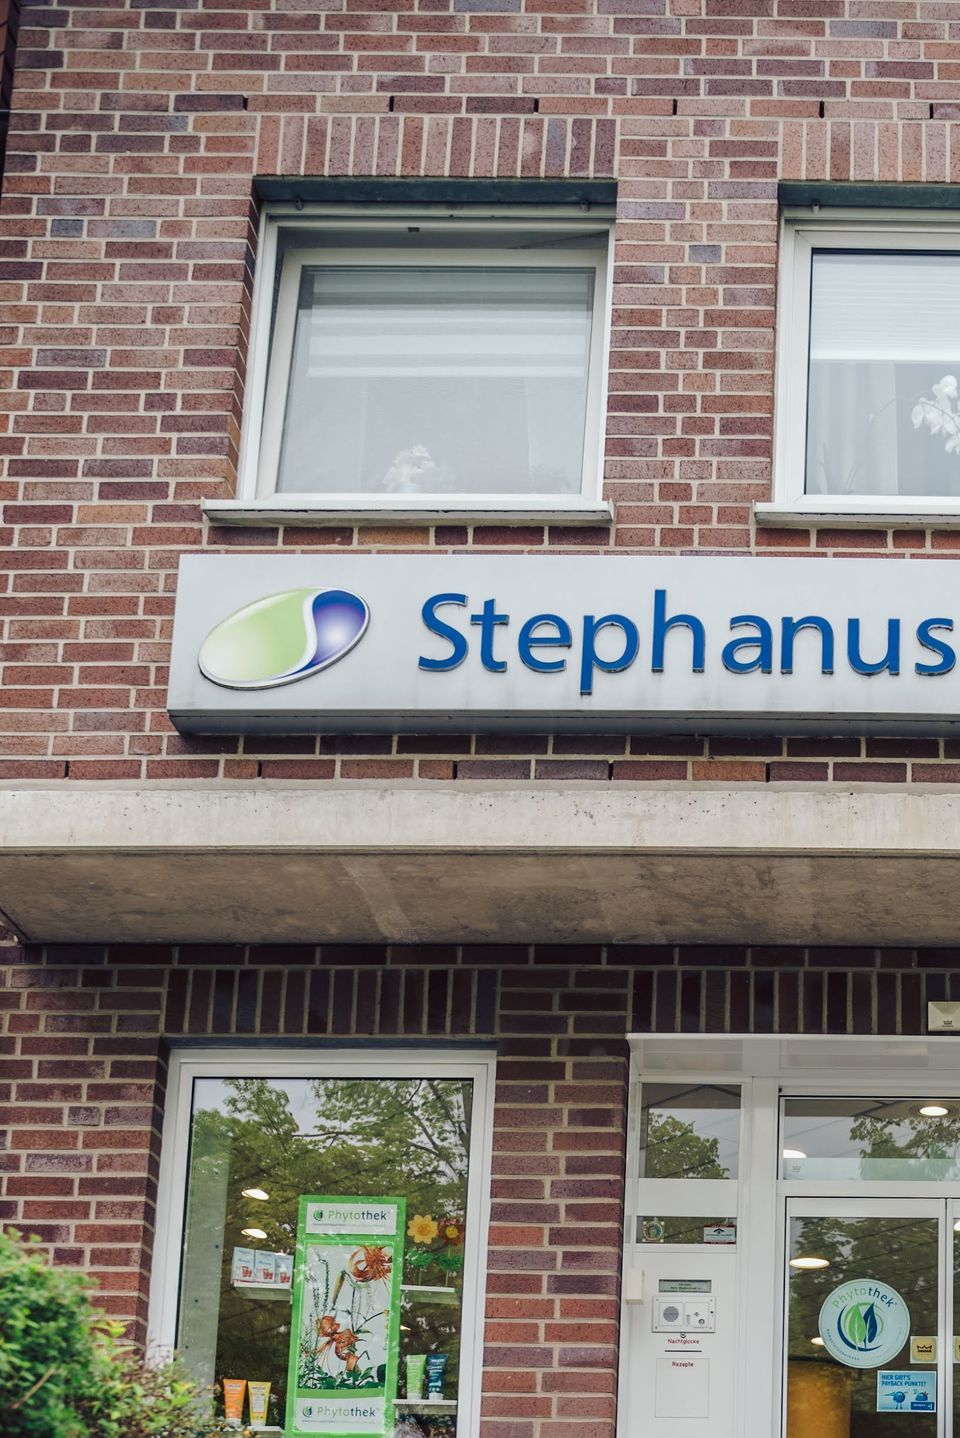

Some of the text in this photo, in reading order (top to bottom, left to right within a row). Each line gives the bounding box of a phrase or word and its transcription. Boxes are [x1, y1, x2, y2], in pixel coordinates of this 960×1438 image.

[418, 588, 956, 695] Stephanus
[328, 1210, 387, 1222] Phytothek
[317, 1406, 376, 1418] Phytothek
